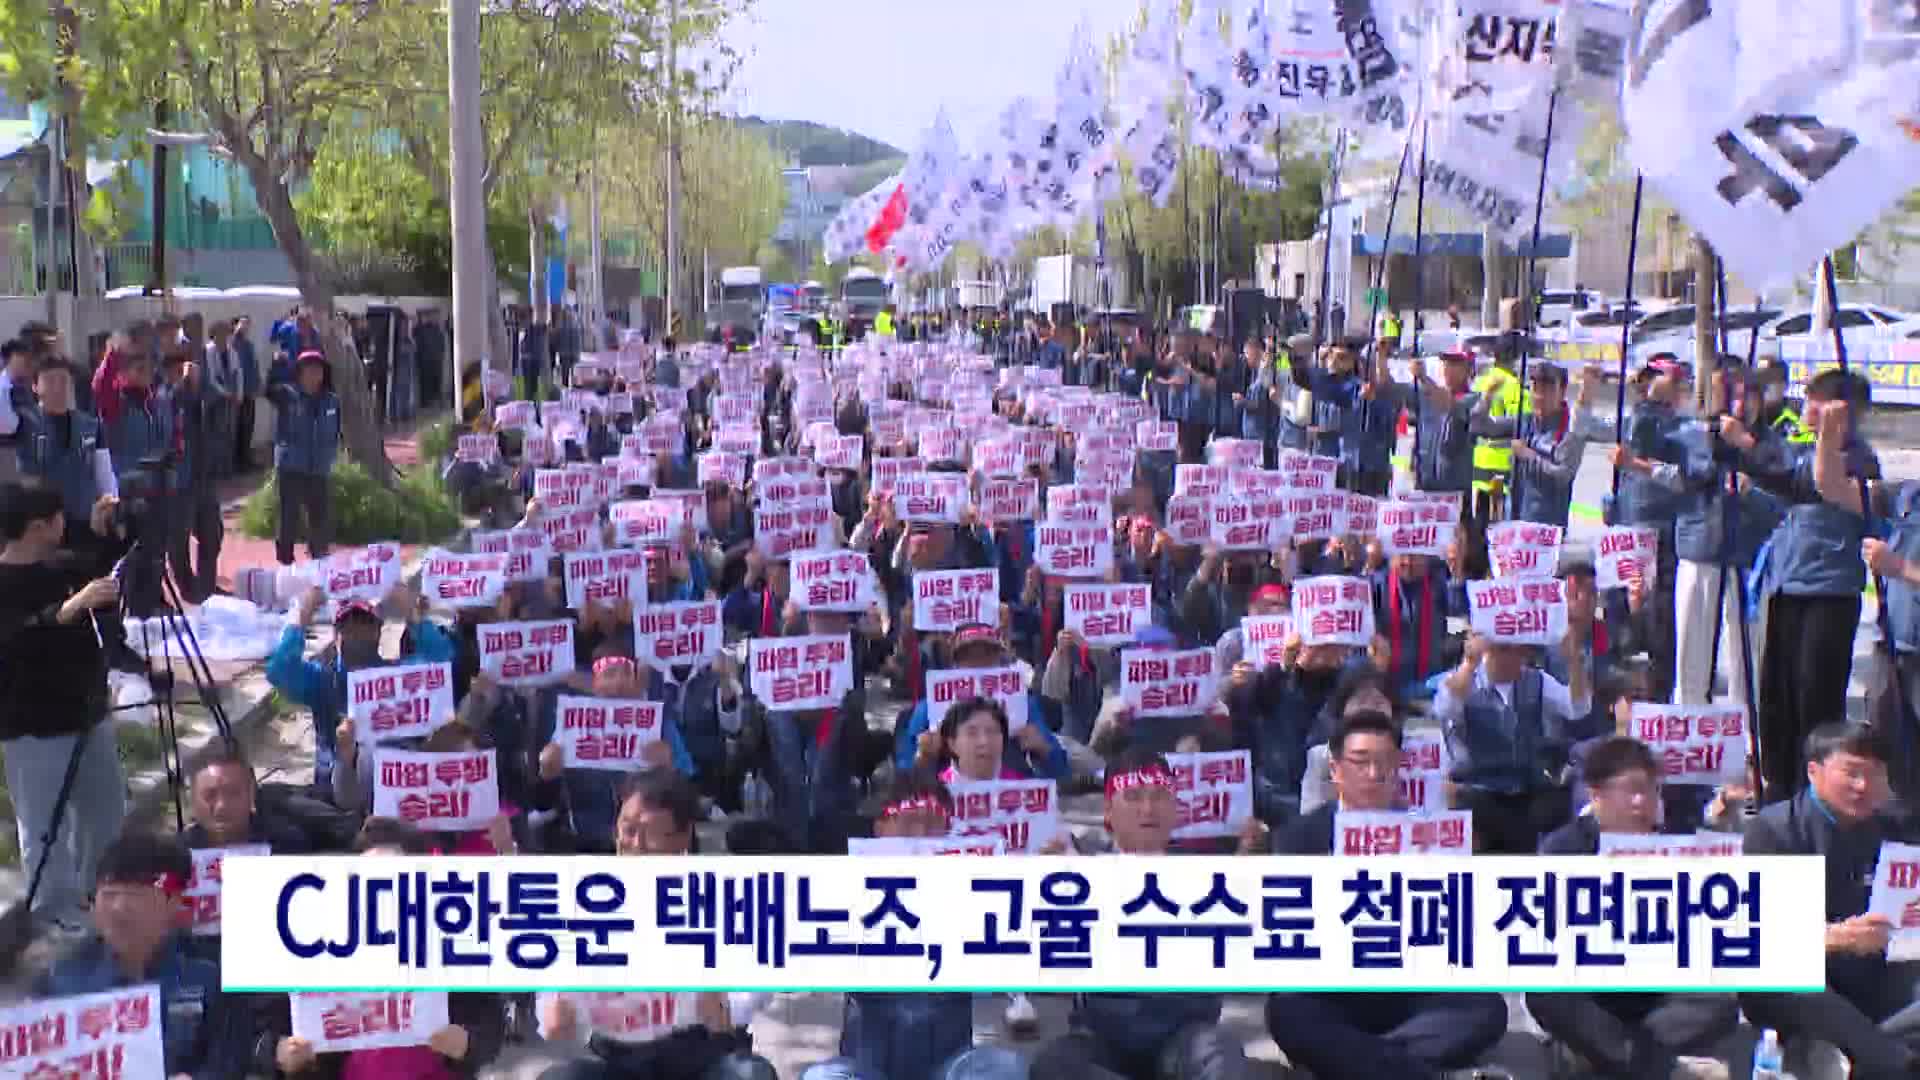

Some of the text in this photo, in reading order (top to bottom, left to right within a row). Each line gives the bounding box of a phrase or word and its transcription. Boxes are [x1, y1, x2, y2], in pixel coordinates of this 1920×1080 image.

[919, 571, 993, 599] 파업 투쟁
[1070, 586, 1146, 612] 파업 투쟁
[1476, 580, 1561, 608] 파업 투쟁
[640, 606, 716, 634] 파업 투쟁
[930, 597, 982, 623] 승리!
[1082, 612, 1132, 637] 승리!
[1494, 610, 1548, 636] 승리!
[484, 623, 568, 653] 파업 투쟁
[655, 631, 704, 657] 승리!
[501, 651, 552, 678] 승리!
[757, 640, 846, 673] 파업 투쟁
[1128, 652, 1213, 683] 파업 투쟁
[354, 668, 445, 703] 파업 투쟁
[772, 669, 832, 703] 승리!
[934, 671, 1021, 703] 파업 투쟁
[1141, 682, 1199, 711] 승리!
[371, 697, 430, 731] 승리!
[564, 706, 656, 730] 파업 투쟁
[1640, 712, 1743, 743] 파업 투쟁
[575, 734, 638, 761] 승리!
[1663, 744, 1724, 776] 승리!
[381, 756, 488, 787] 파업 투쟁
[1200, 757, 1246, 786] 투쟁
[398, 791, 471, 821] 승리!
[998, 787, 1049, 814] 투쟁
[1344, 816, 1465, 856] 파업 투쟁
[78, 993, 150, 1040] 투쟁
[321, 995, 414, 1040] 승리!
